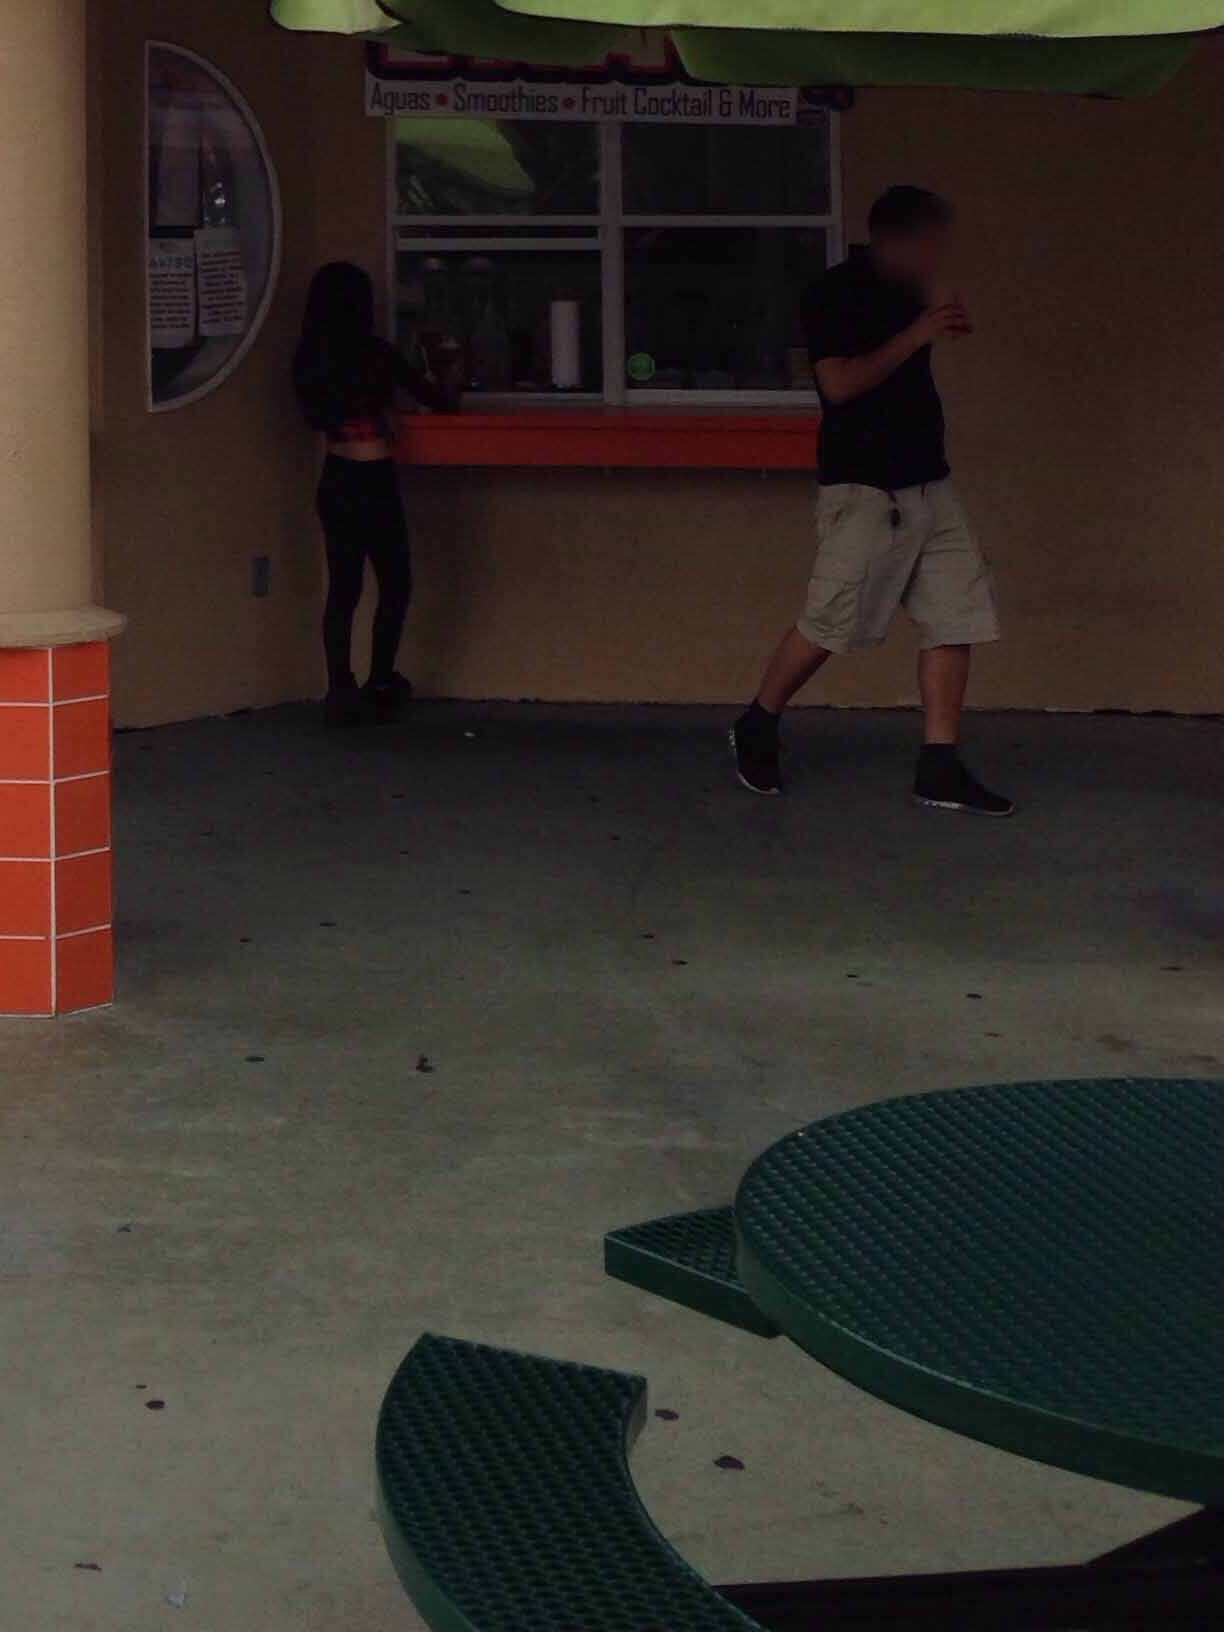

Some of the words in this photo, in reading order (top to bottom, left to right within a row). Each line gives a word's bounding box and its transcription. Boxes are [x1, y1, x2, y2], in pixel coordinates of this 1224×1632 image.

[371, 85, 431, 114] Aguas
[454, 85, 559, 114] Smoothies
[581, 89, 628, 116] Fruit
[634, 88, 713, 118] Cocktail
[719, 90, 732, 117] &
[739, 90, 791, 119] More
